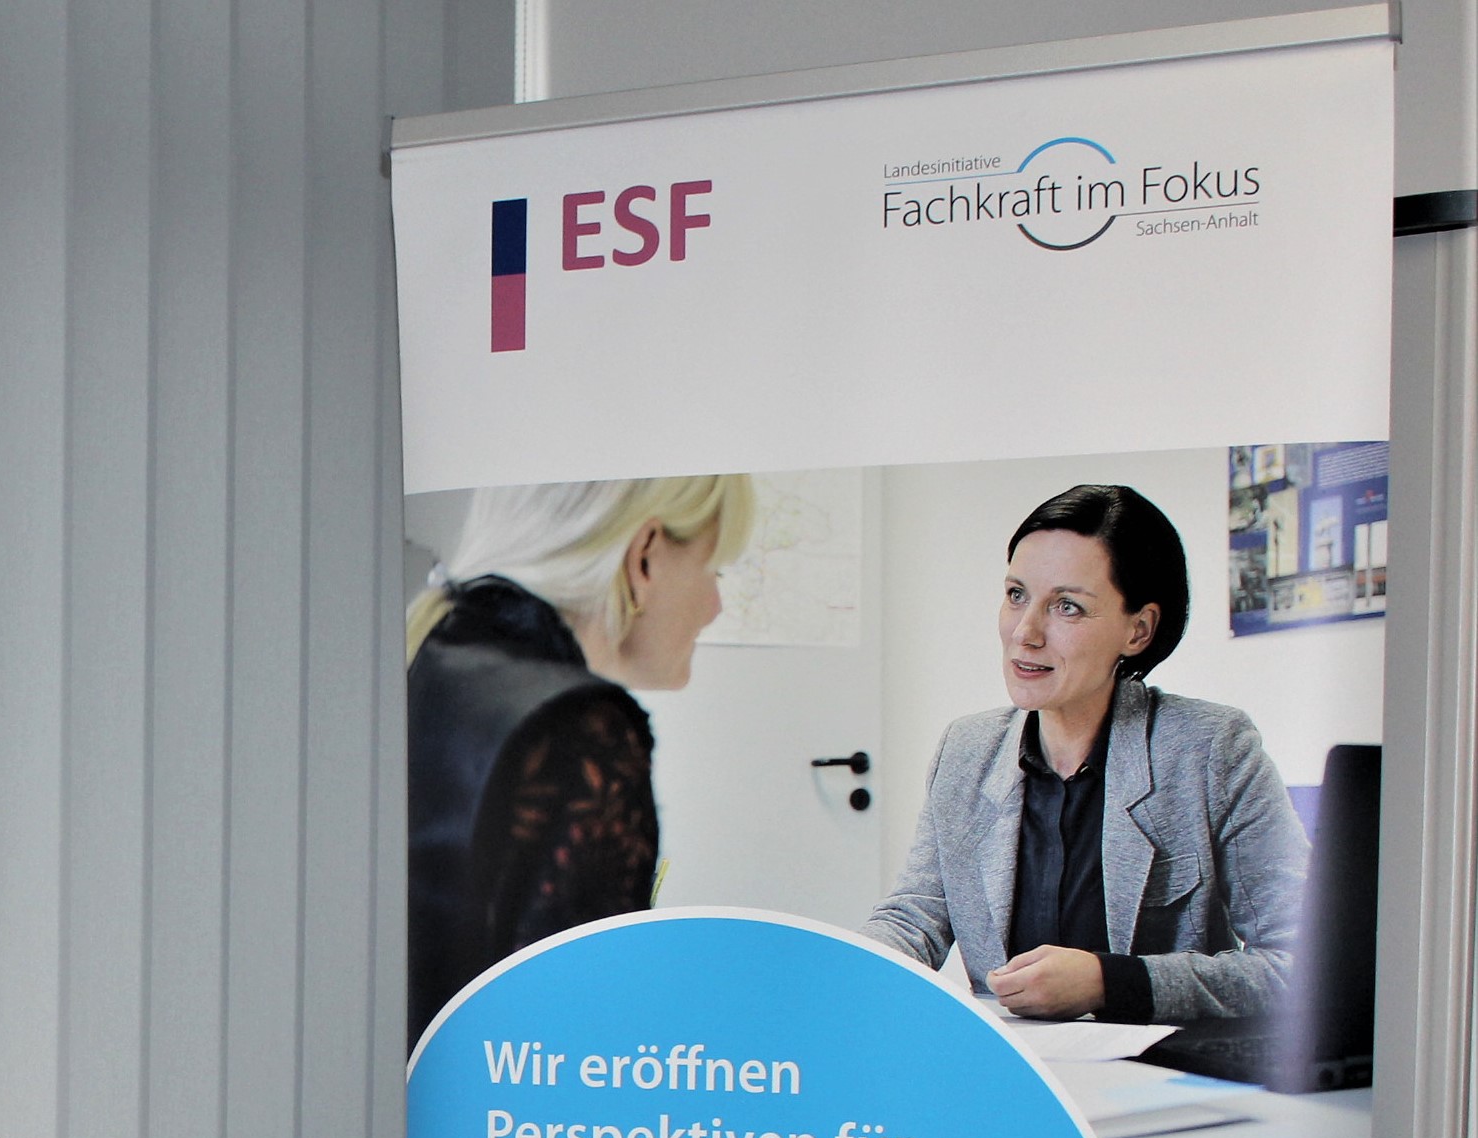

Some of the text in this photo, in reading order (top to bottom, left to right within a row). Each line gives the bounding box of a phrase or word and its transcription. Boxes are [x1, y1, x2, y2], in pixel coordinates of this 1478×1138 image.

[883, 155, 1001, 179] Landesinitiative
[883, 161, 1260, 228] Fachkraft im Fokus
[561, 179, 713, 272] ESF
[1135, 211, 1259, 236] Sachsen-Anhalt
[483, 1041, 801, 1095] Wir eröffnen
